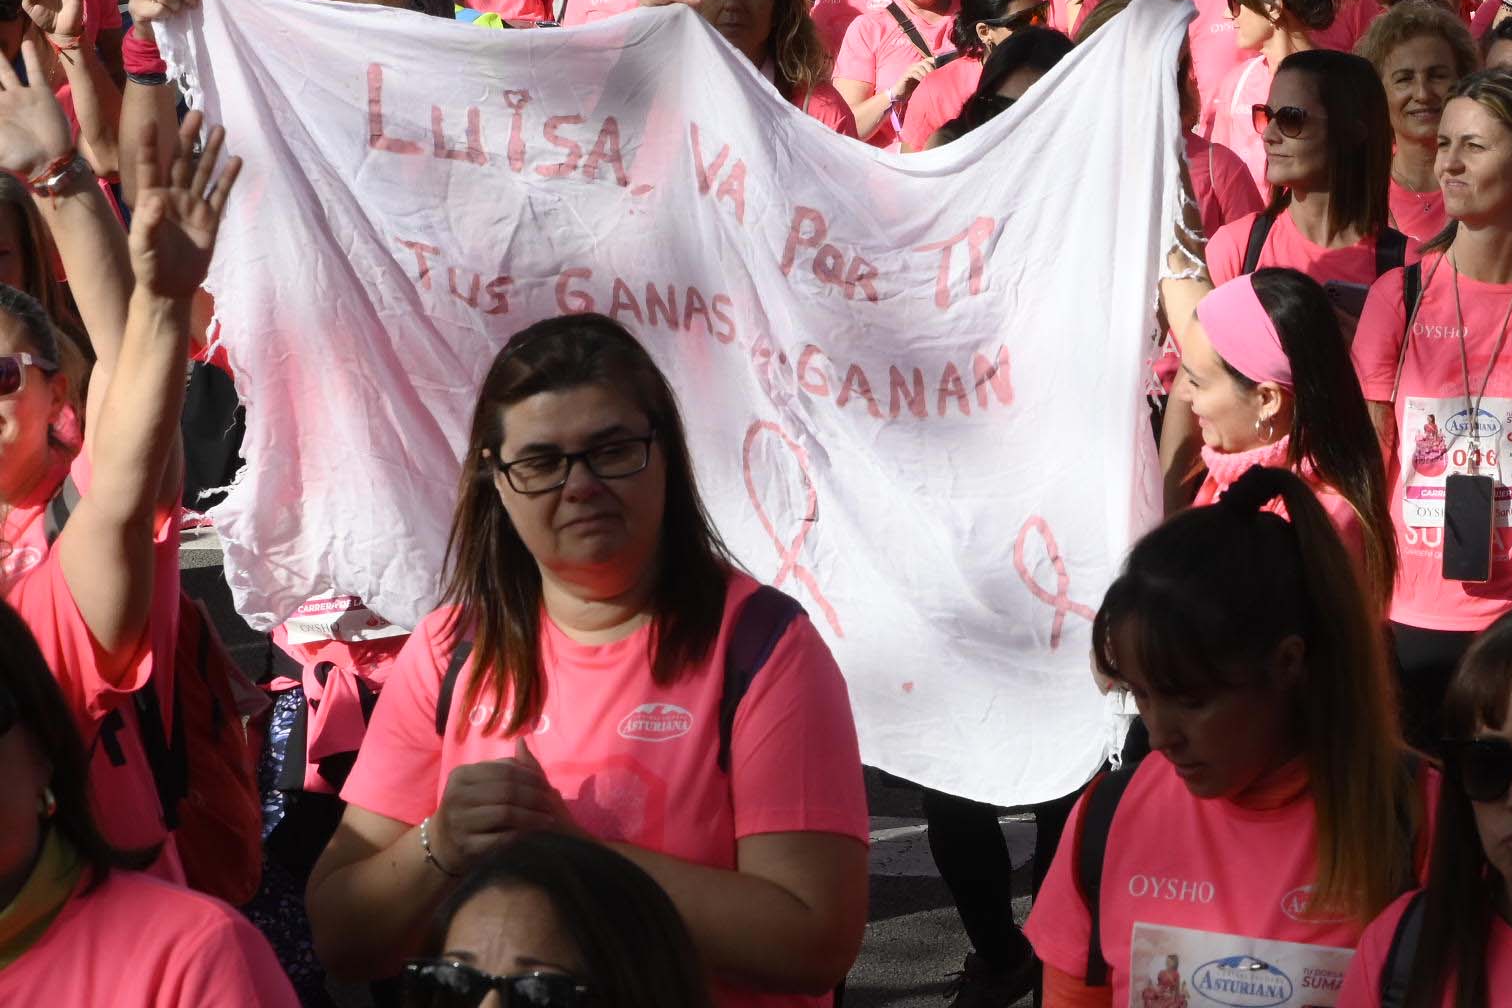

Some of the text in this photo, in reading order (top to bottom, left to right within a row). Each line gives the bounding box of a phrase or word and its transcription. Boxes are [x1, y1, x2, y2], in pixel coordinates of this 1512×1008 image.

[397, 238, 511, 315] TUS
[797, 344, 1015, 420] GANAN
[1412, 322, 1469, 339] OYSHO
[625, 719, 690, 733] ASTURIANA
[1128, 874, 1215, 904] OYSHO
[1200, 970, 1285, 1000] ASTURIANA
